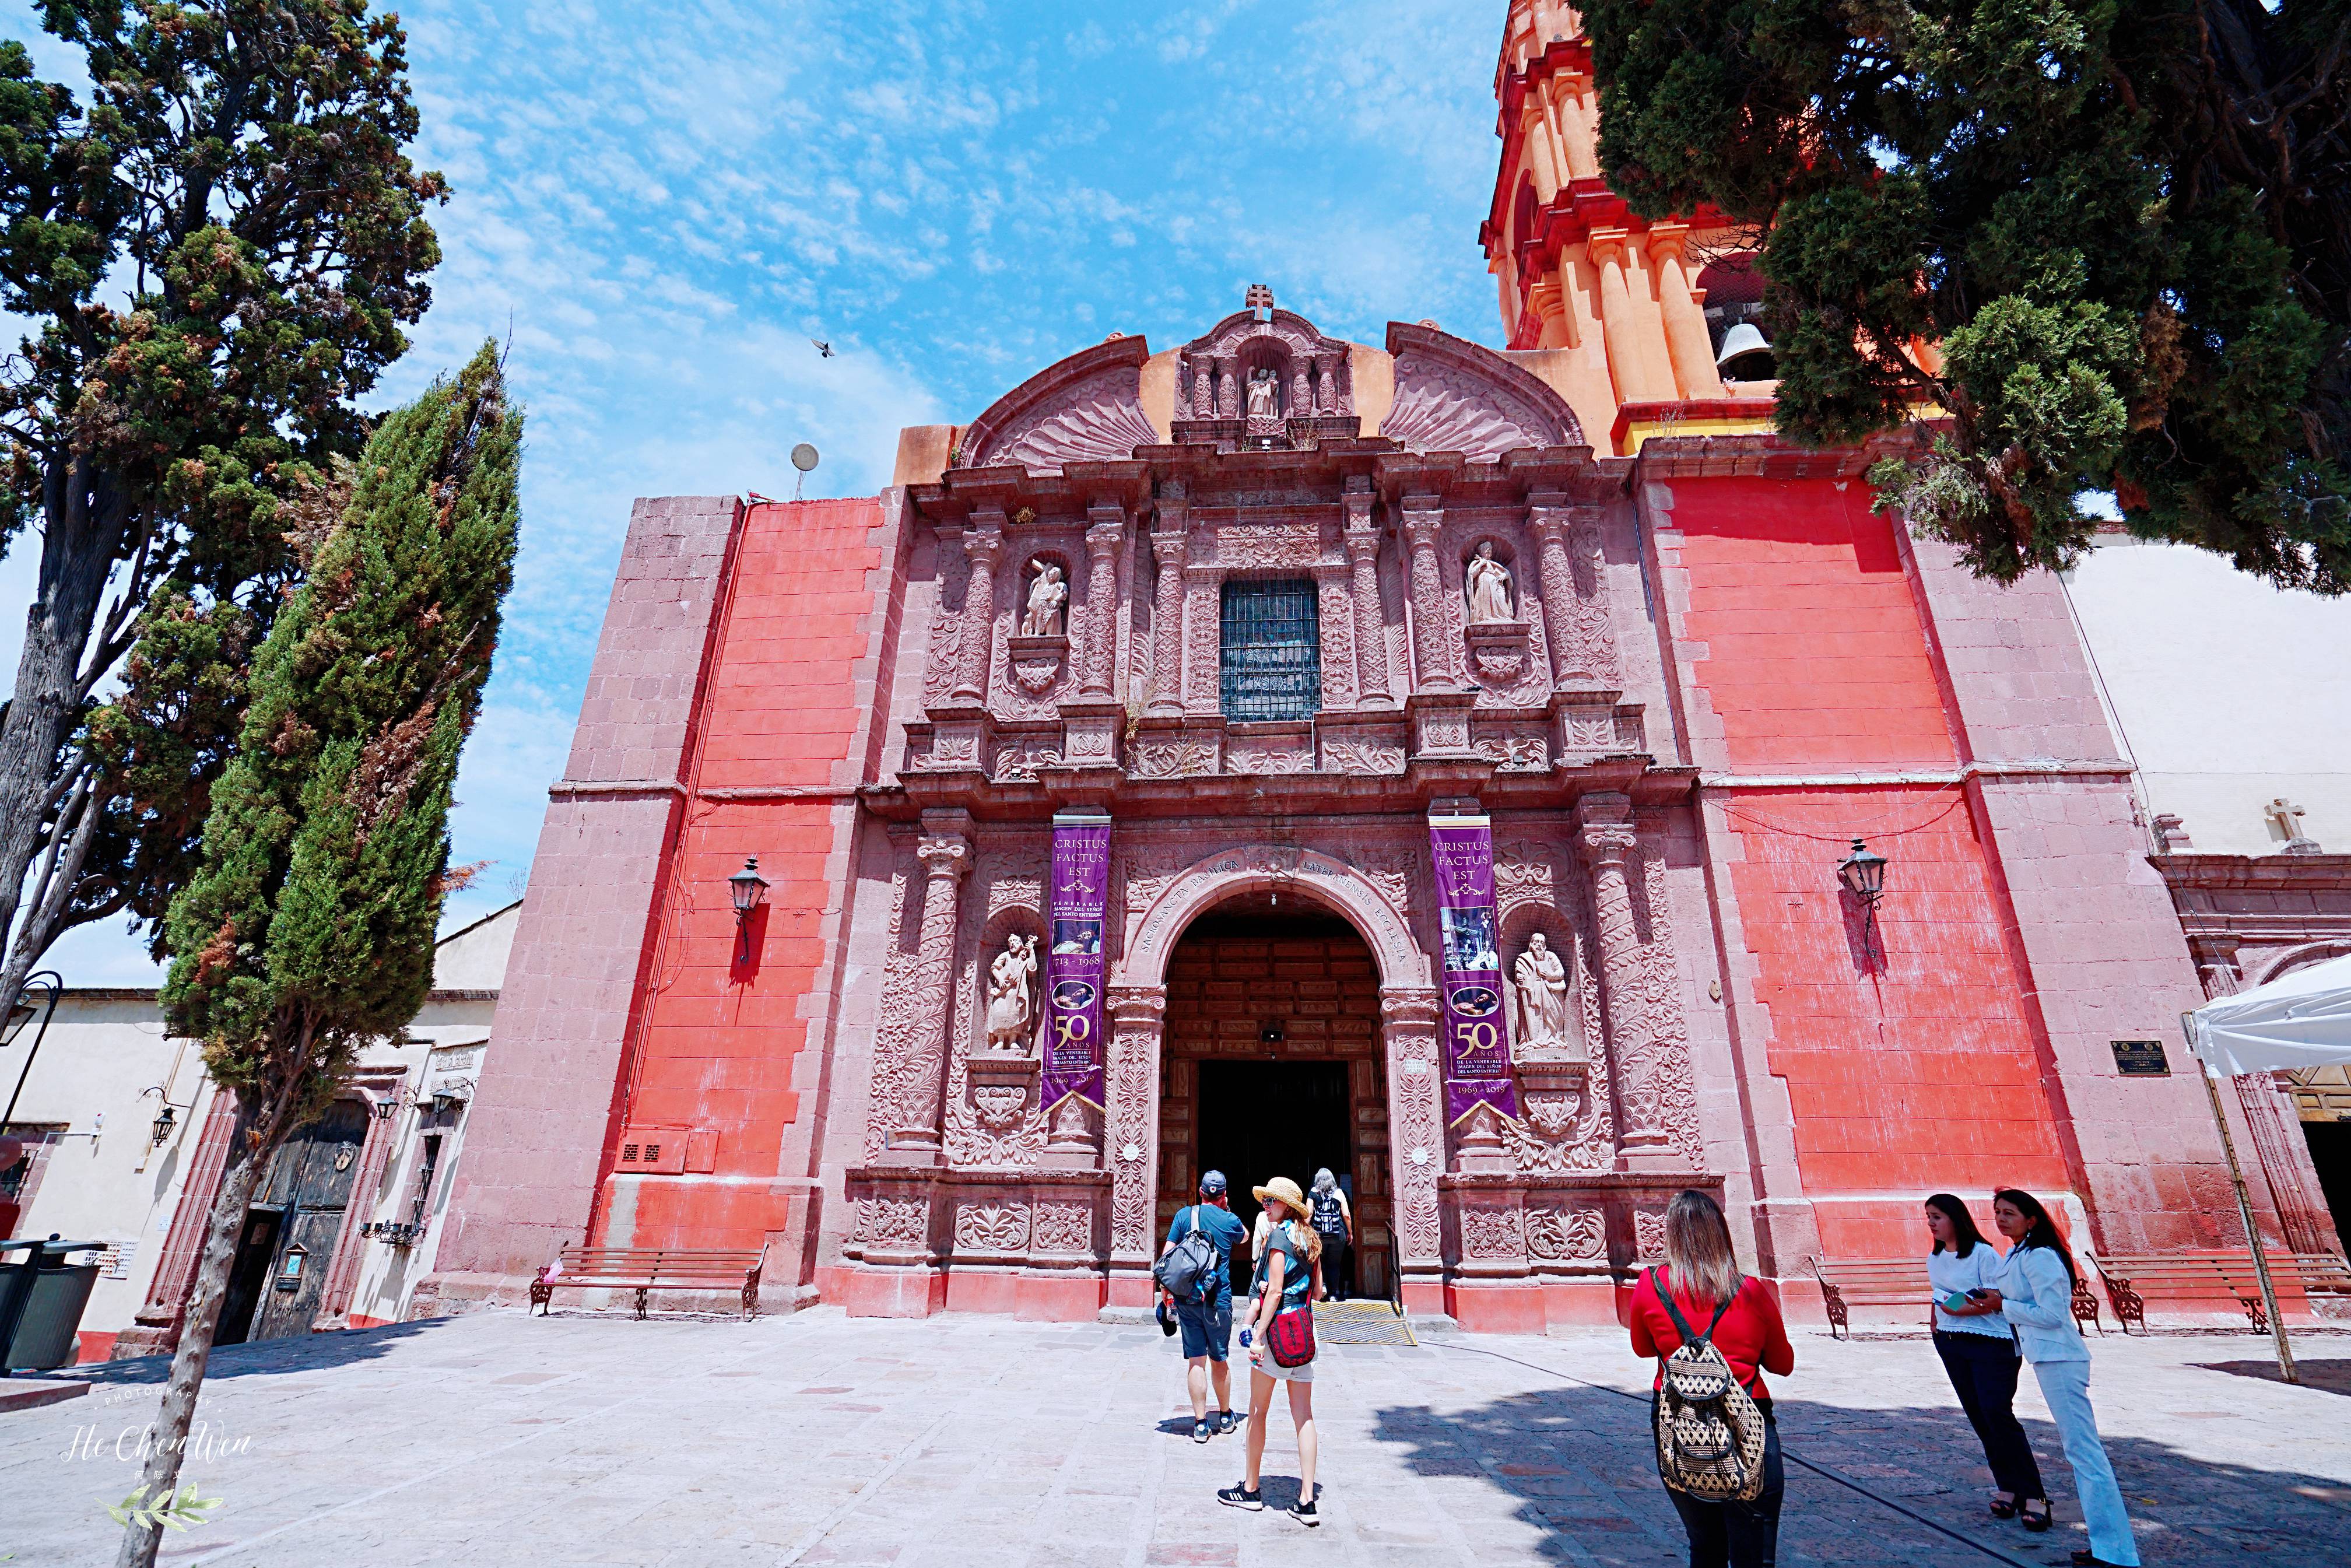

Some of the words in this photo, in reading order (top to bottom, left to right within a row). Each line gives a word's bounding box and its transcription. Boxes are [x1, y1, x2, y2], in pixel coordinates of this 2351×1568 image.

[1055, 839, 1107, 848] CRISTUS
[1435, 841, 1489, 851] CRISTUS
[1056, 853, 1104, 863] FACTUS
[1438, 855, 1488, 866] FACTUS
[1068, 867, 1090, 876] EST
[1453, 871, 1475, 881] EST
[1079, 956, 1100, 967] 1968
[1053, 1015, 1090, 1051] 50
[1457, 1022, 1497, 1059] 50
[1051, 1077, 1068, 1085] 1969
[1076, 1075, 1094, 1084] 2019
[1458, 1086, 1478, 1095] 1969
